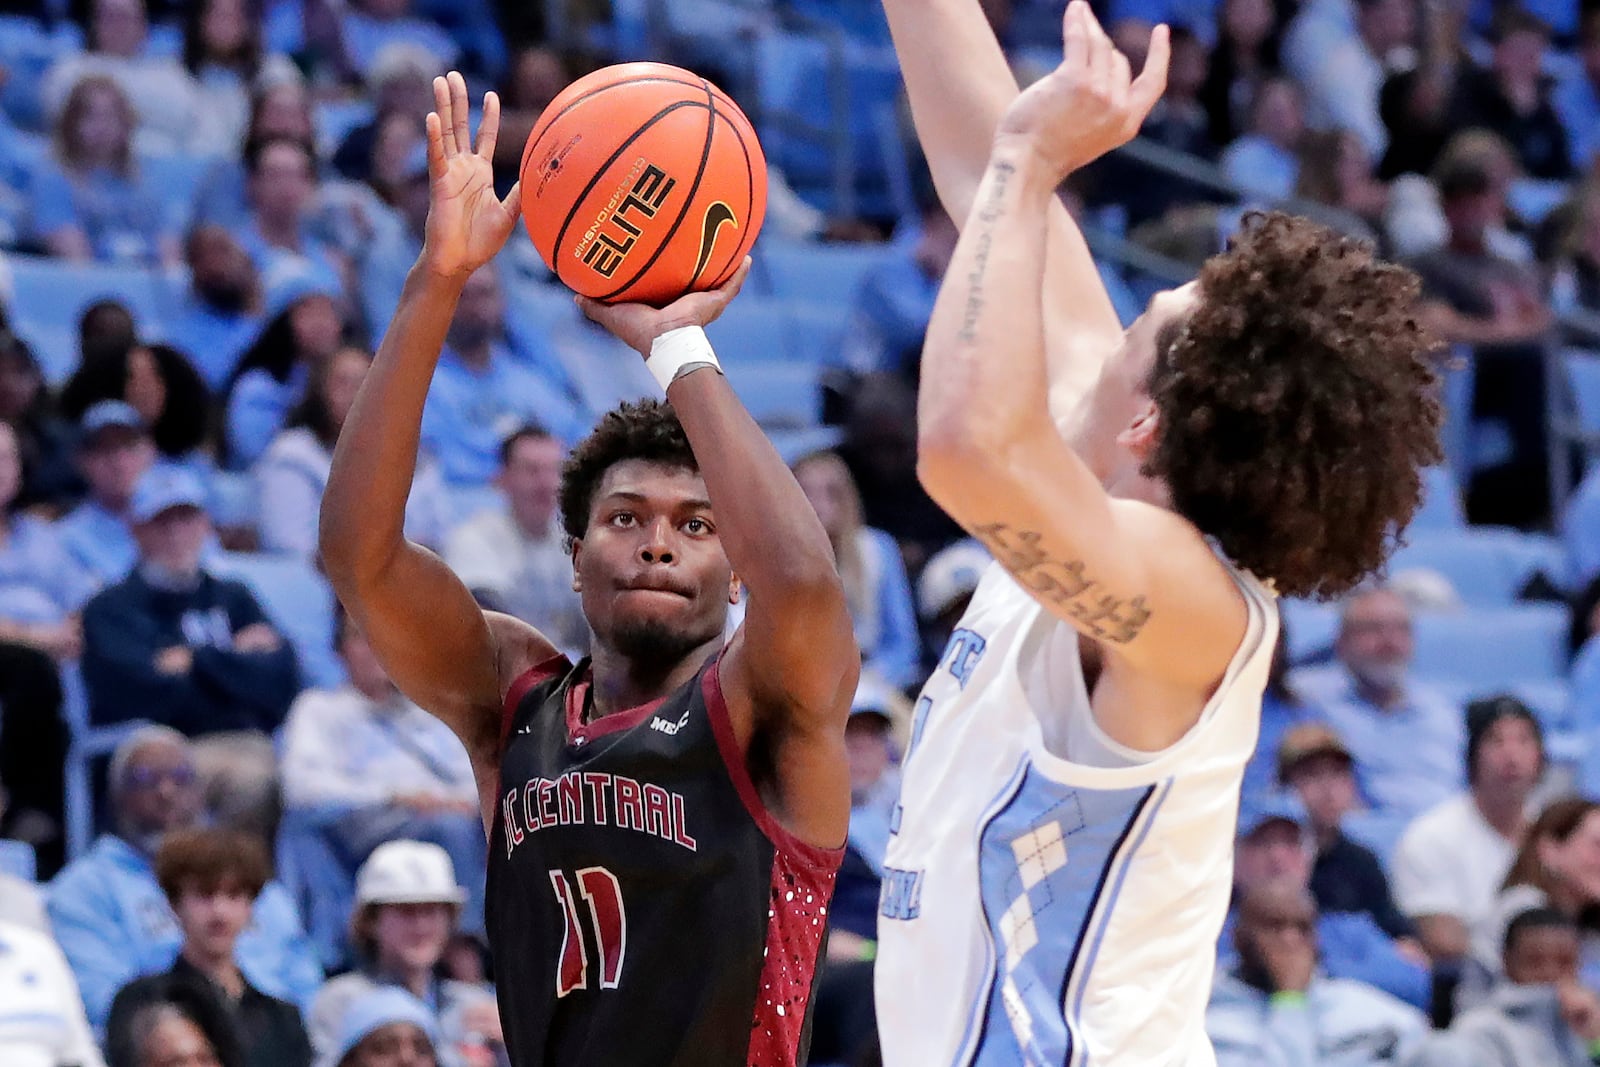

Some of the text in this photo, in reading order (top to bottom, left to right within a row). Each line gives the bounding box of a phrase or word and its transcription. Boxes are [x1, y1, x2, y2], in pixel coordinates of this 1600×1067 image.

[574, 157, 646, 258] CHAMPIONSHIP
[581, 163, 676, 279] ELITE
[524, 771, 697, 852] CENTRAL
[549, 866, 627, 998] 11
